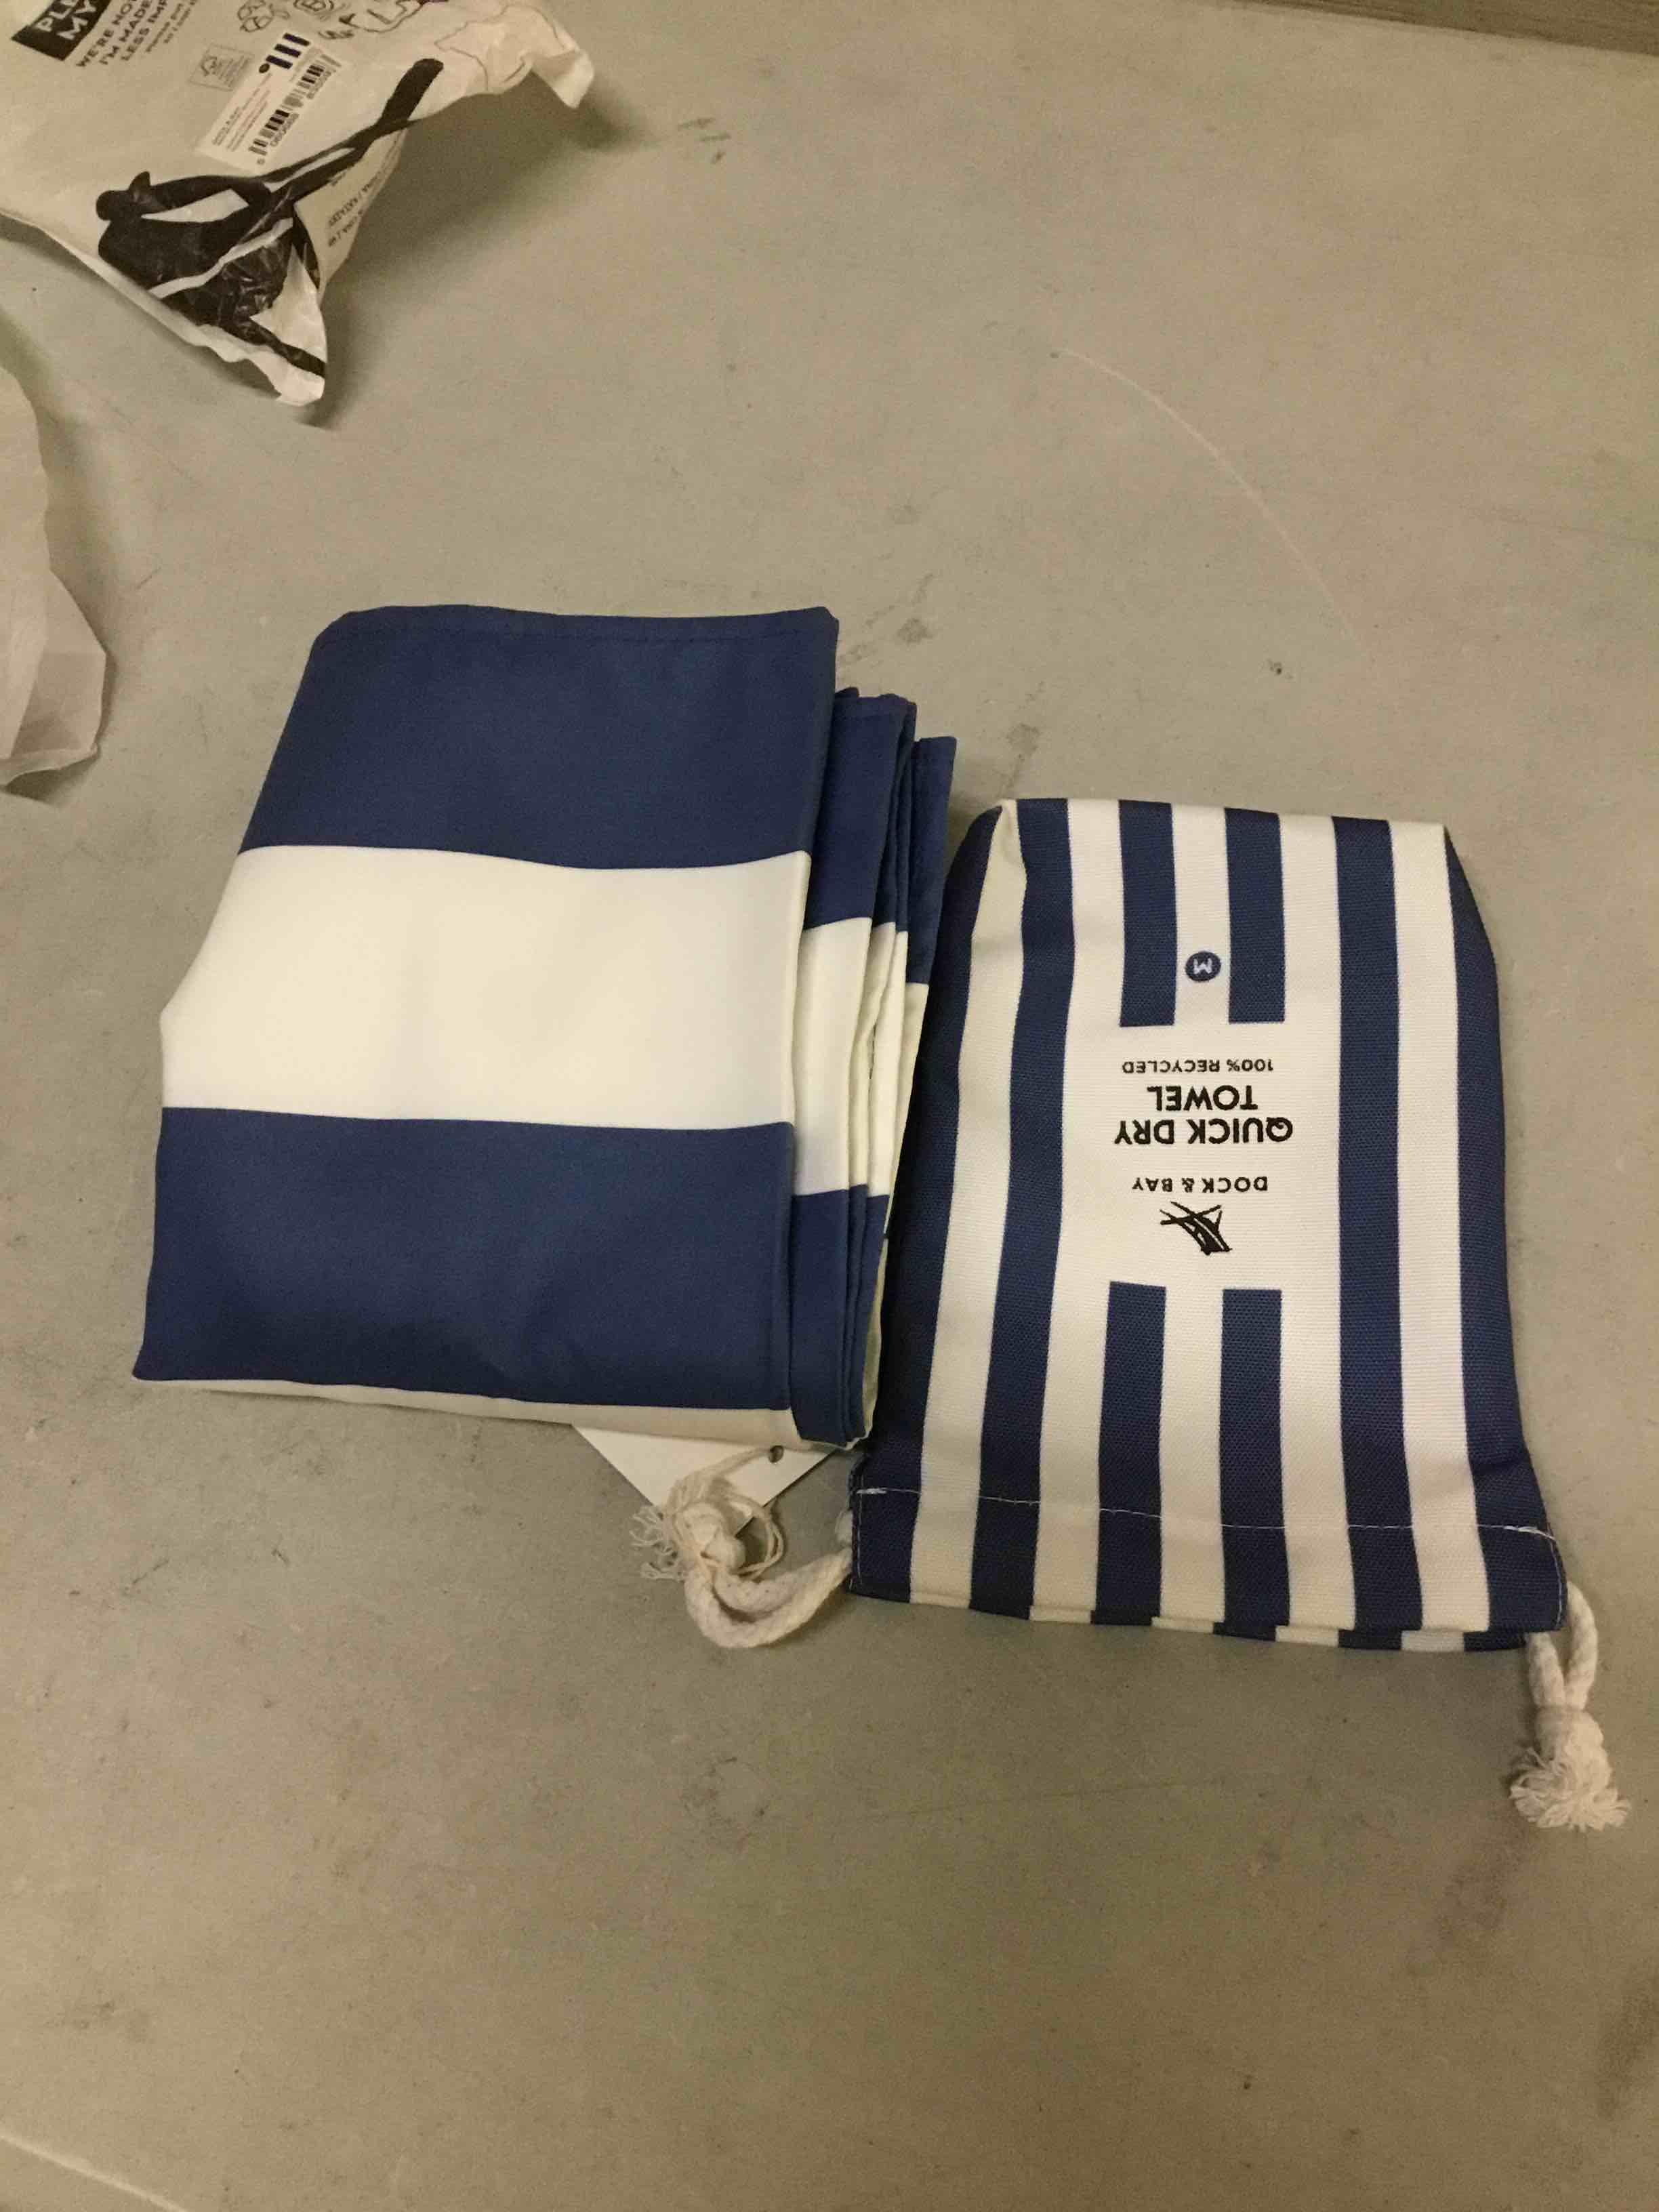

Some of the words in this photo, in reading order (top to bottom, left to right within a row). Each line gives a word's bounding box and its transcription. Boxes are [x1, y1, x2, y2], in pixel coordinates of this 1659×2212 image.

[56, 0, 97, 40] MY
[75, 28, 115, 67] WE'RE
[112, 0, 136, 26] NO
[119, 0, 152, 42] MADE
[120, 27, 150, 62] LESS
[1193, 958, 1212, 975] M
[1122, 1059, 1221, 1074] RECYCLED
[1226, 1058, 1274, 1072] 100%
[1147, 1084, 1258, 1111] TOWEL
[1114, 1118, 1175, 1145] DRY
[1185, 1117, 1294, 1145] QUICK
[1131, 1176, 1173, 1193] BAY
[1181, 1176, 1195, 1193] &
[1201, 1176, 1269, 1194] DOCK
